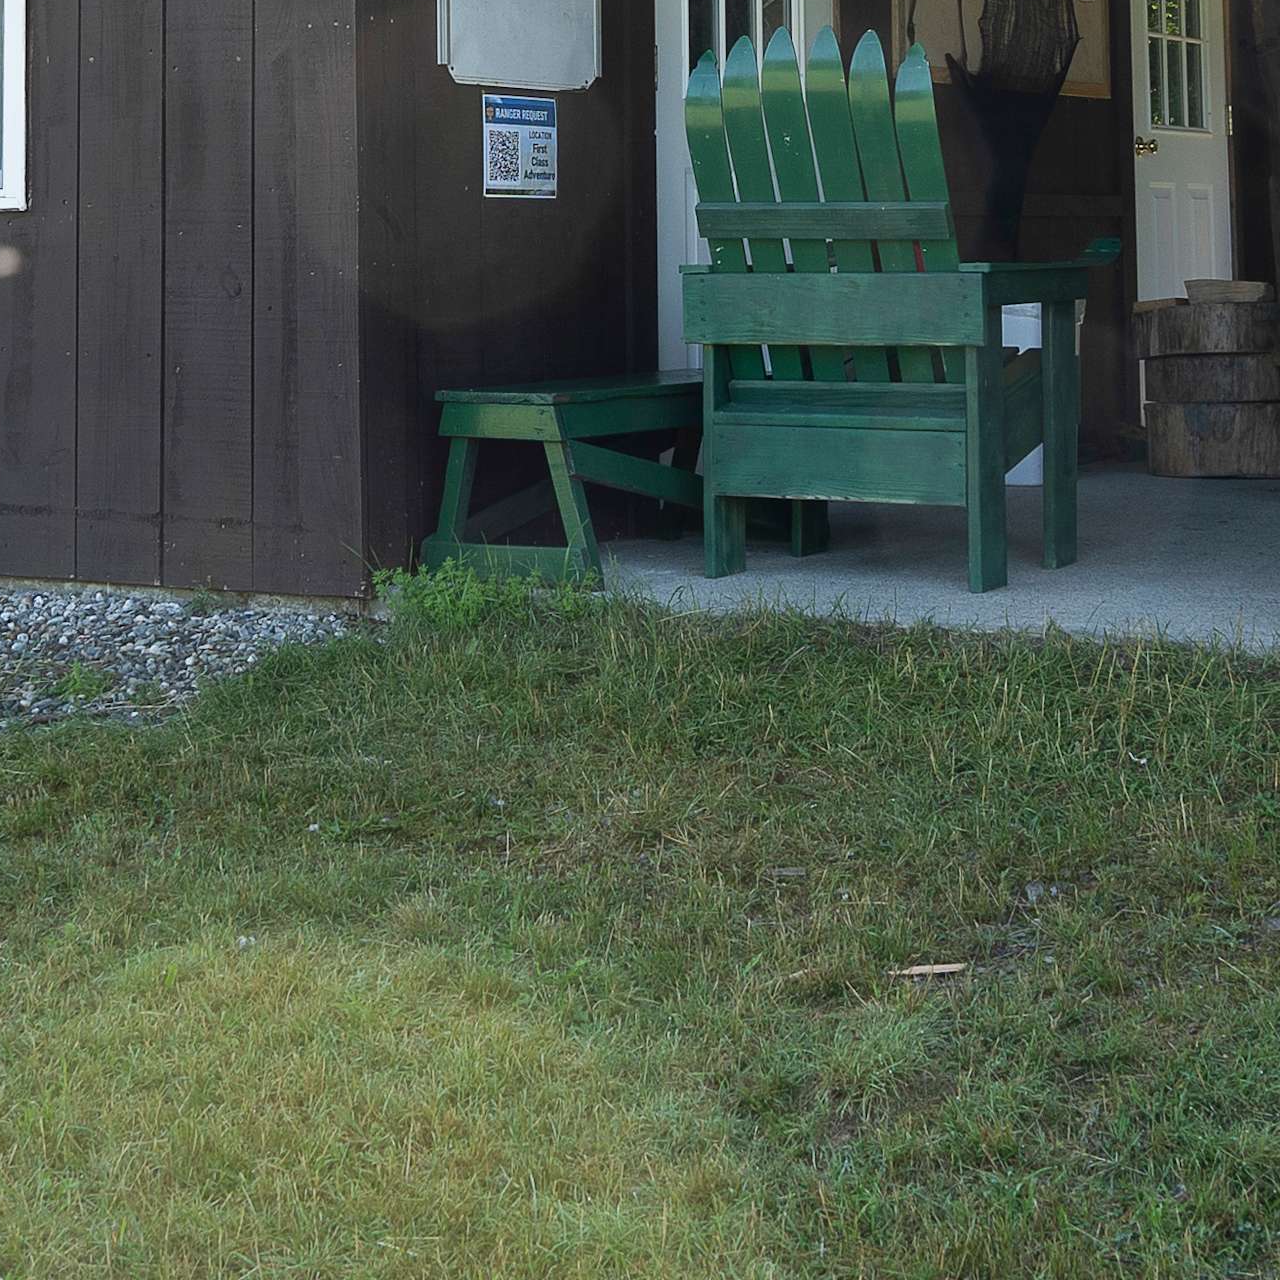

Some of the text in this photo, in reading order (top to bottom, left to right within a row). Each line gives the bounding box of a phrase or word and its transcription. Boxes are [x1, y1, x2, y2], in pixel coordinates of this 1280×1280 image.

[495, 107, 548, 122] RANGER REQUEST
[532, 143, 548, 154] First
[531, 156, 549, 167] Class
